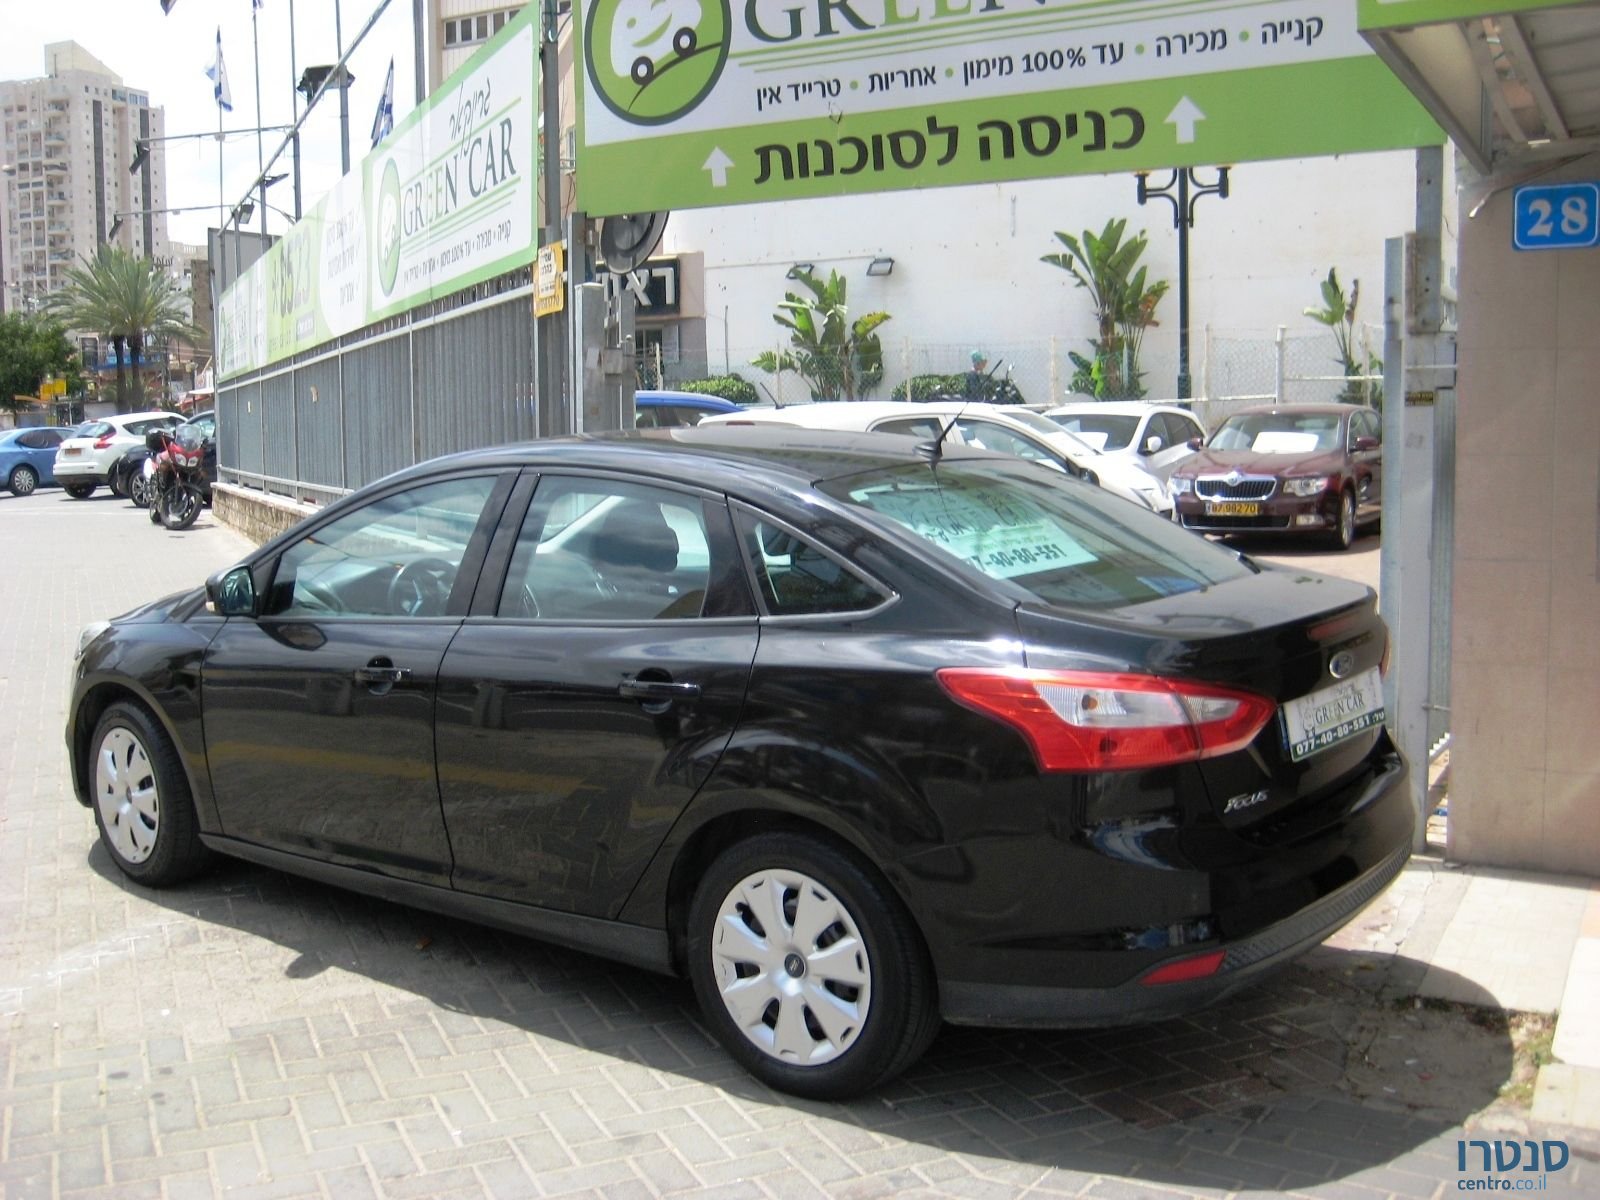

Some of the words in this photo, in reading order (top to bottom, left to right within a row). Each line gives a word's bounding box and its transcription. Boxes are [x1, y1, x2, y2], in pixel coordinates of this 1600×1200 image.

[1155, 28, 1228, 57] מכירה
[1261, 16, 1324, 46] קנייה
[1021, 46, 1086, 73] 100%
[1092, 41, 1125, 65] עד
[868, 65, 937, 92] אחריות
[963, 54, 1014, 86] מימון
[756, 85, 781, 111] אין
[787, 77, 842, 100] טרייד
[977, 106, 1146, 162] כניסה
[754, 115, 960, 185] לסוכנות
[403, 153, 459, 237] GREEN
[467, 117, 517, 198] CAR
[1527, 197, 1588, 237] 28
[1346, 693, 1365, 716] CAR
[1296, 716, 1371, 755] 077-40-80-551
